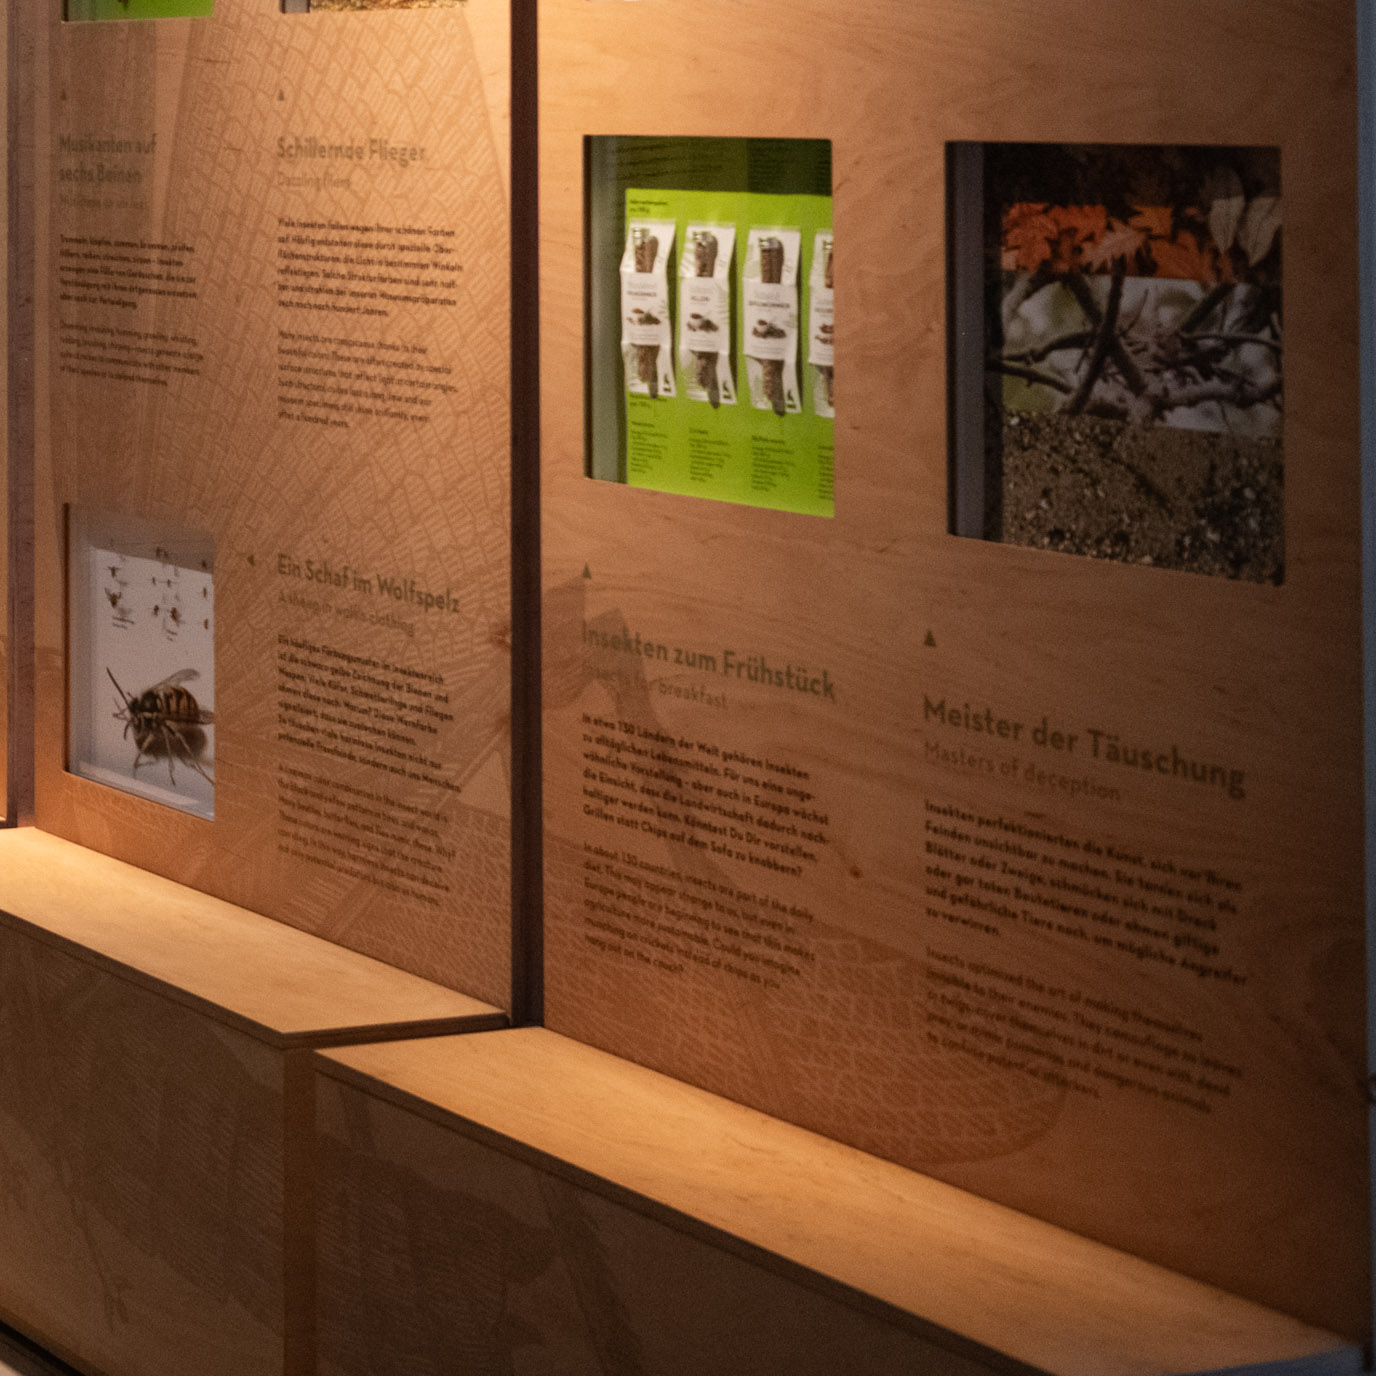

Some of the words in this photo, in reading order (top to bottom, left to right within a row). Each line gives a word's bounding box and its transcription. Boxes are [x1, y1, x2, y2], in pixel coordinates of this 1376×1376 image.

[277, 553, 301, 577] Ein
[305, 559, 349, 588] Schaf
[353, 570, 372, 594] im
[376, 573, 460, 613] Wolfspelz
[582, 620, 669, 662] Insekten
[673, 647, 717, 672] zum
[723, 649, 835, 698] Frühstück
[924, 695, 1023, 741] Meister
[1032, 717, 1078, 752] der
[1087, 728, 1245, 799] Täuschung
